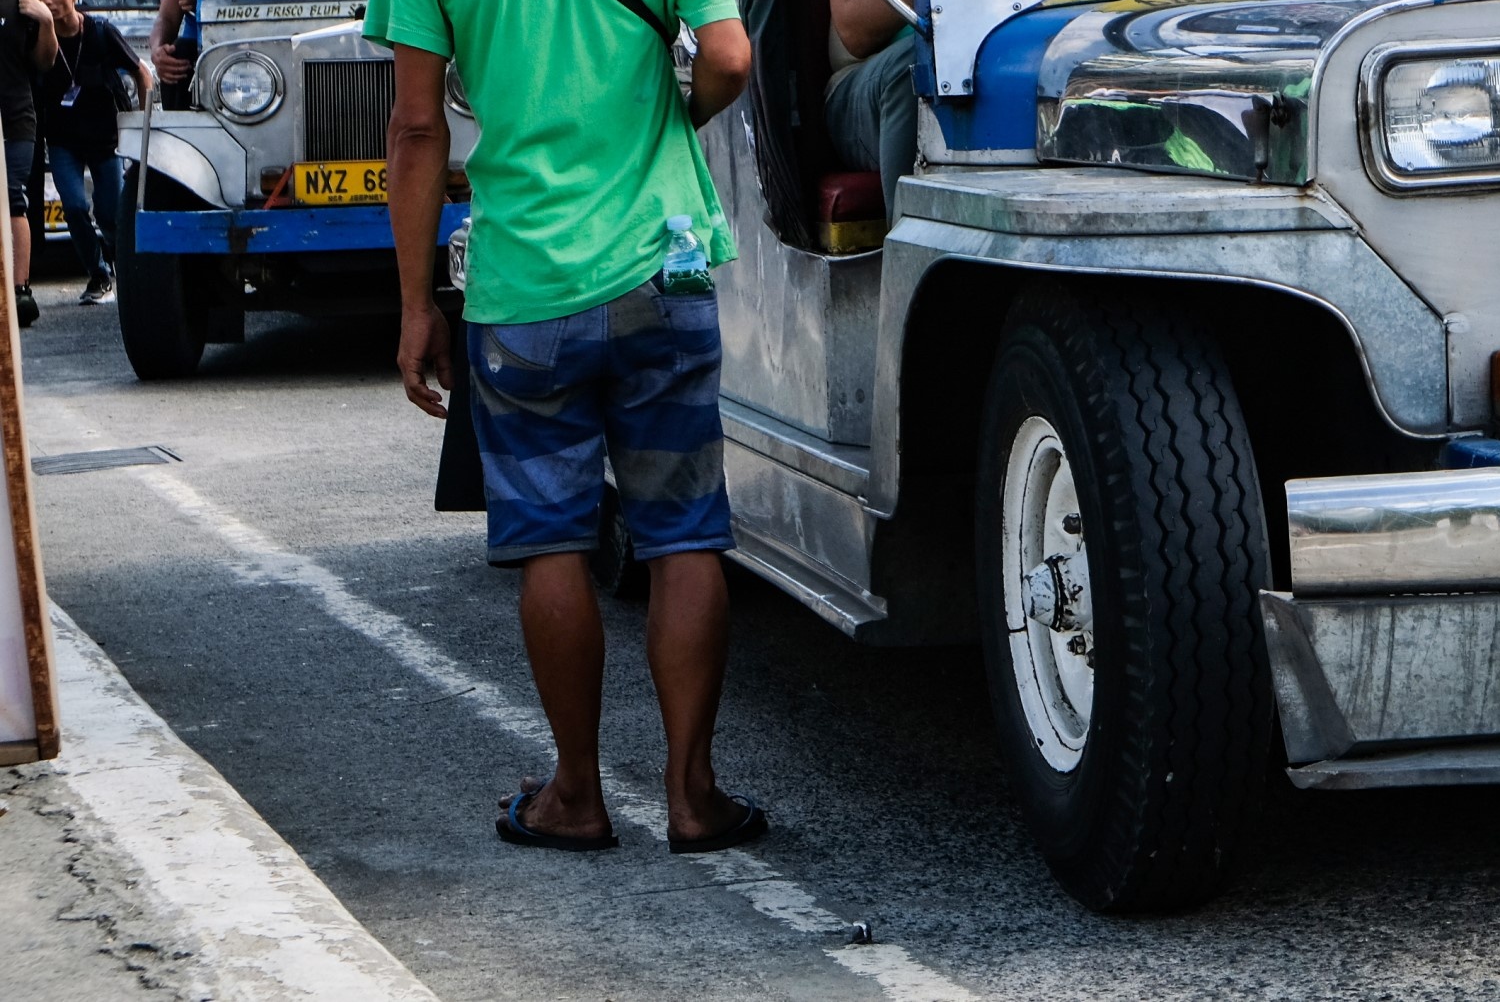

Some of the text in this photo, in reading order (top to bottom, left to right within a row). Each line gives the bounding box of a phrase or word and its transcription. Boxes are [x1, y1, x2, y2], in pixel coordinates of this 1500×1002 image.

[216, 5, 260, 19] MUÑOZ
[266, 4, 304, 17] FRISCO
[306, 169, 348, 194] NXZ
